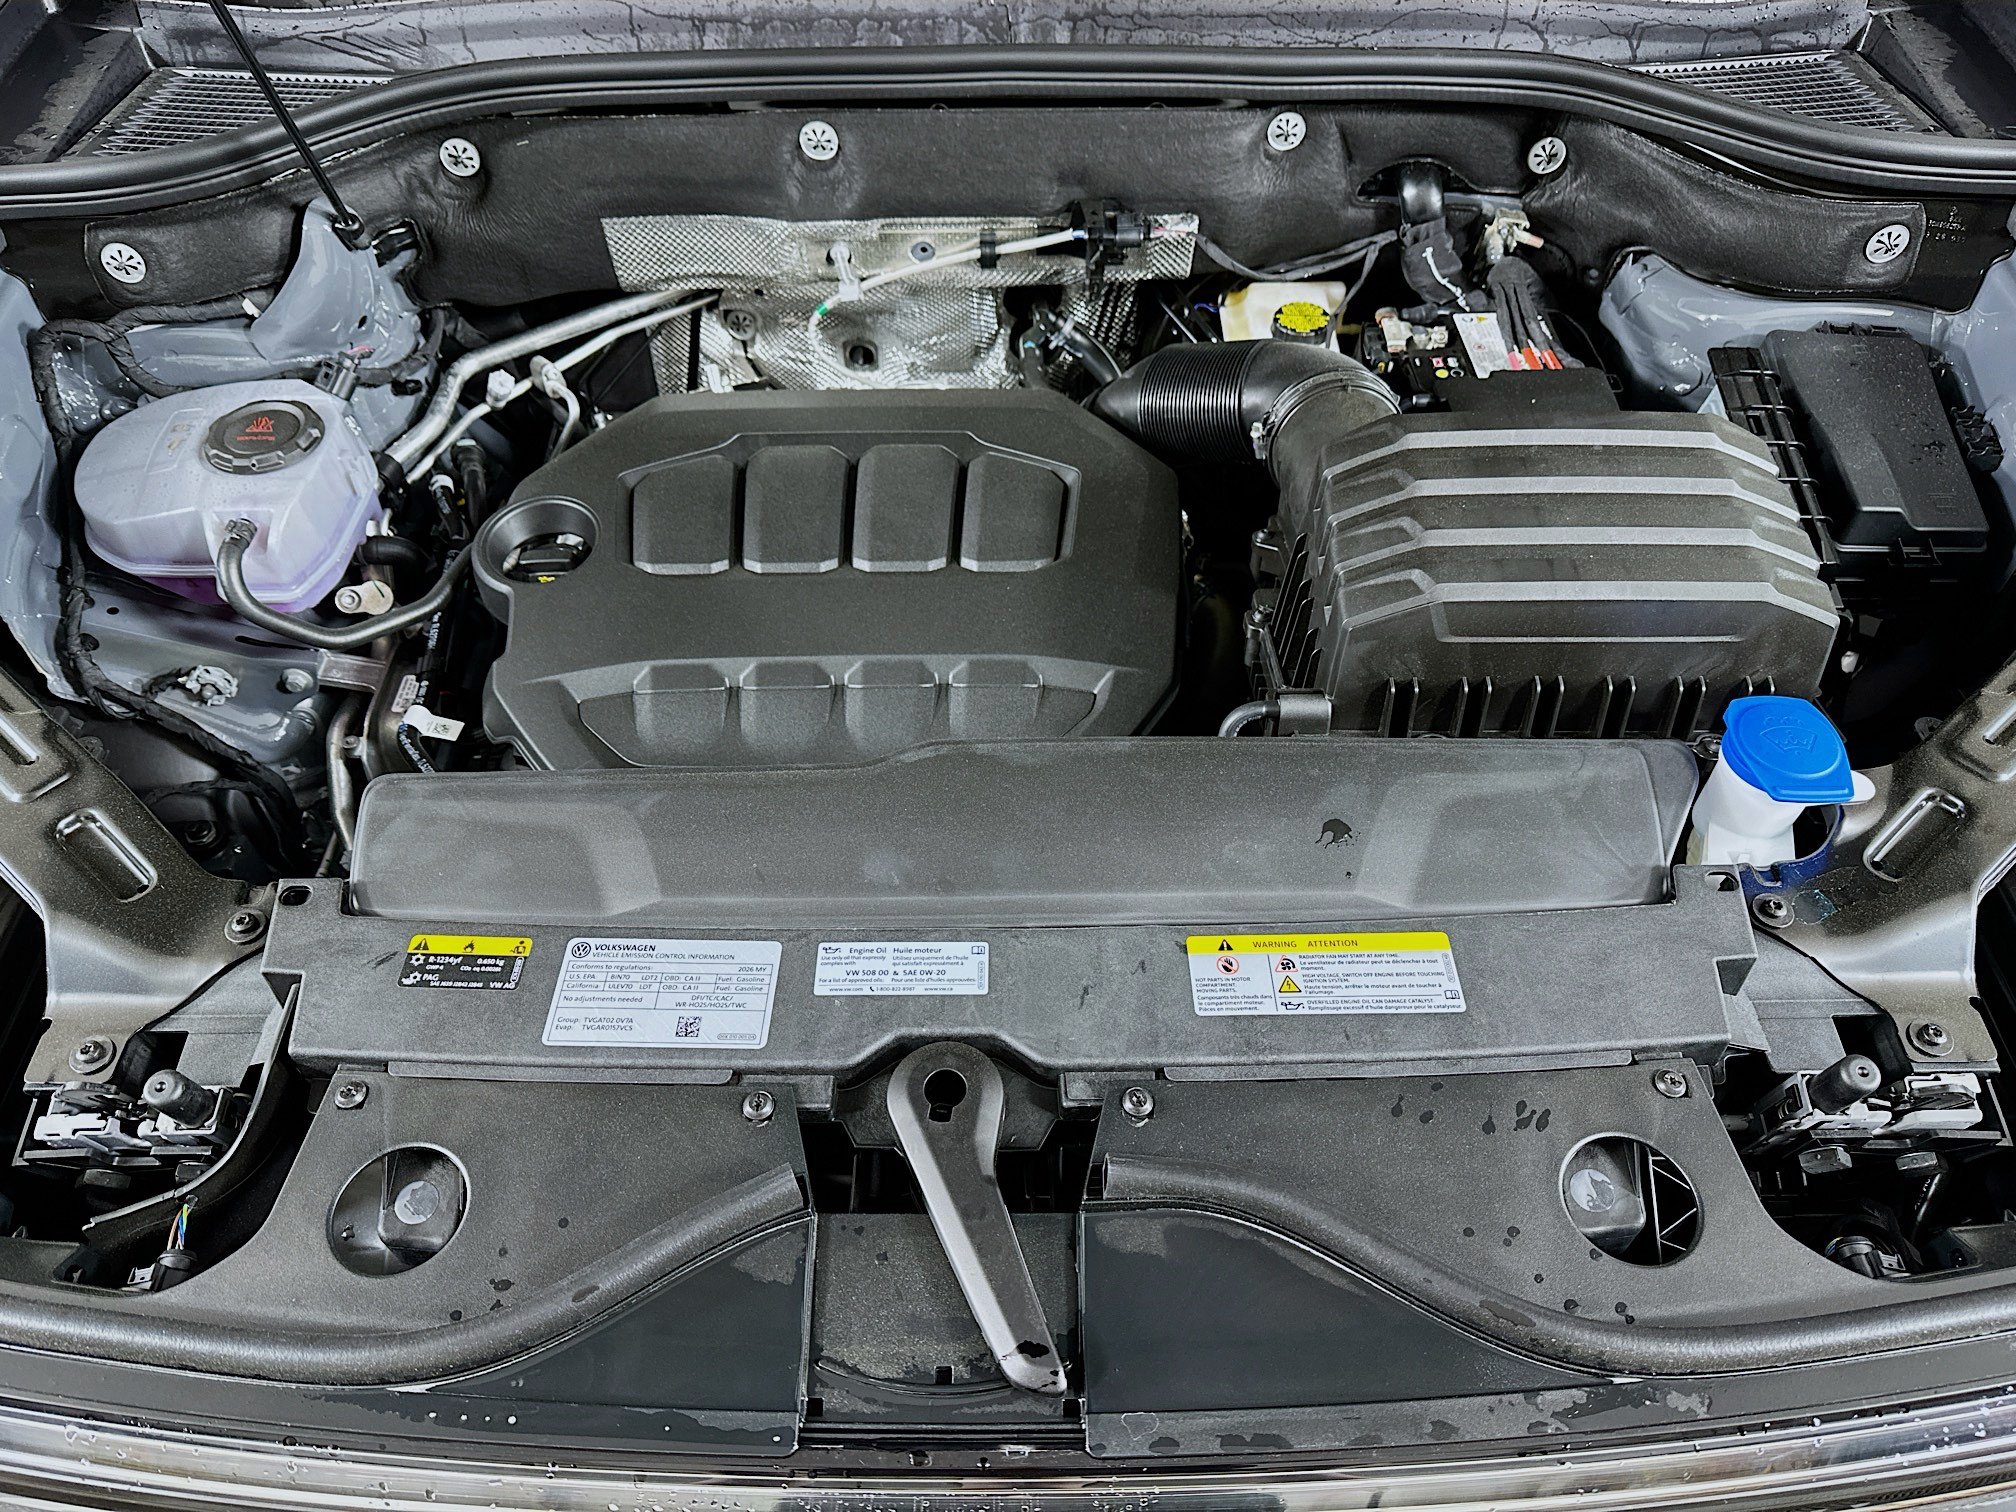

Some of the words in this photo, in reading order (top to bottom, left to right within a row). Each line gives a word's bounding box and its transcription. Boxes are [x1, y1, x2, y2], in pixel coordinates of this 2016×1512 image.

[572, 942, 591, 958] VW
[594, 943, 656, 952] VOLKSWAGEN
[428, 956, 463, 965] R-1234yf
[496, 958, 505, 966] kg
